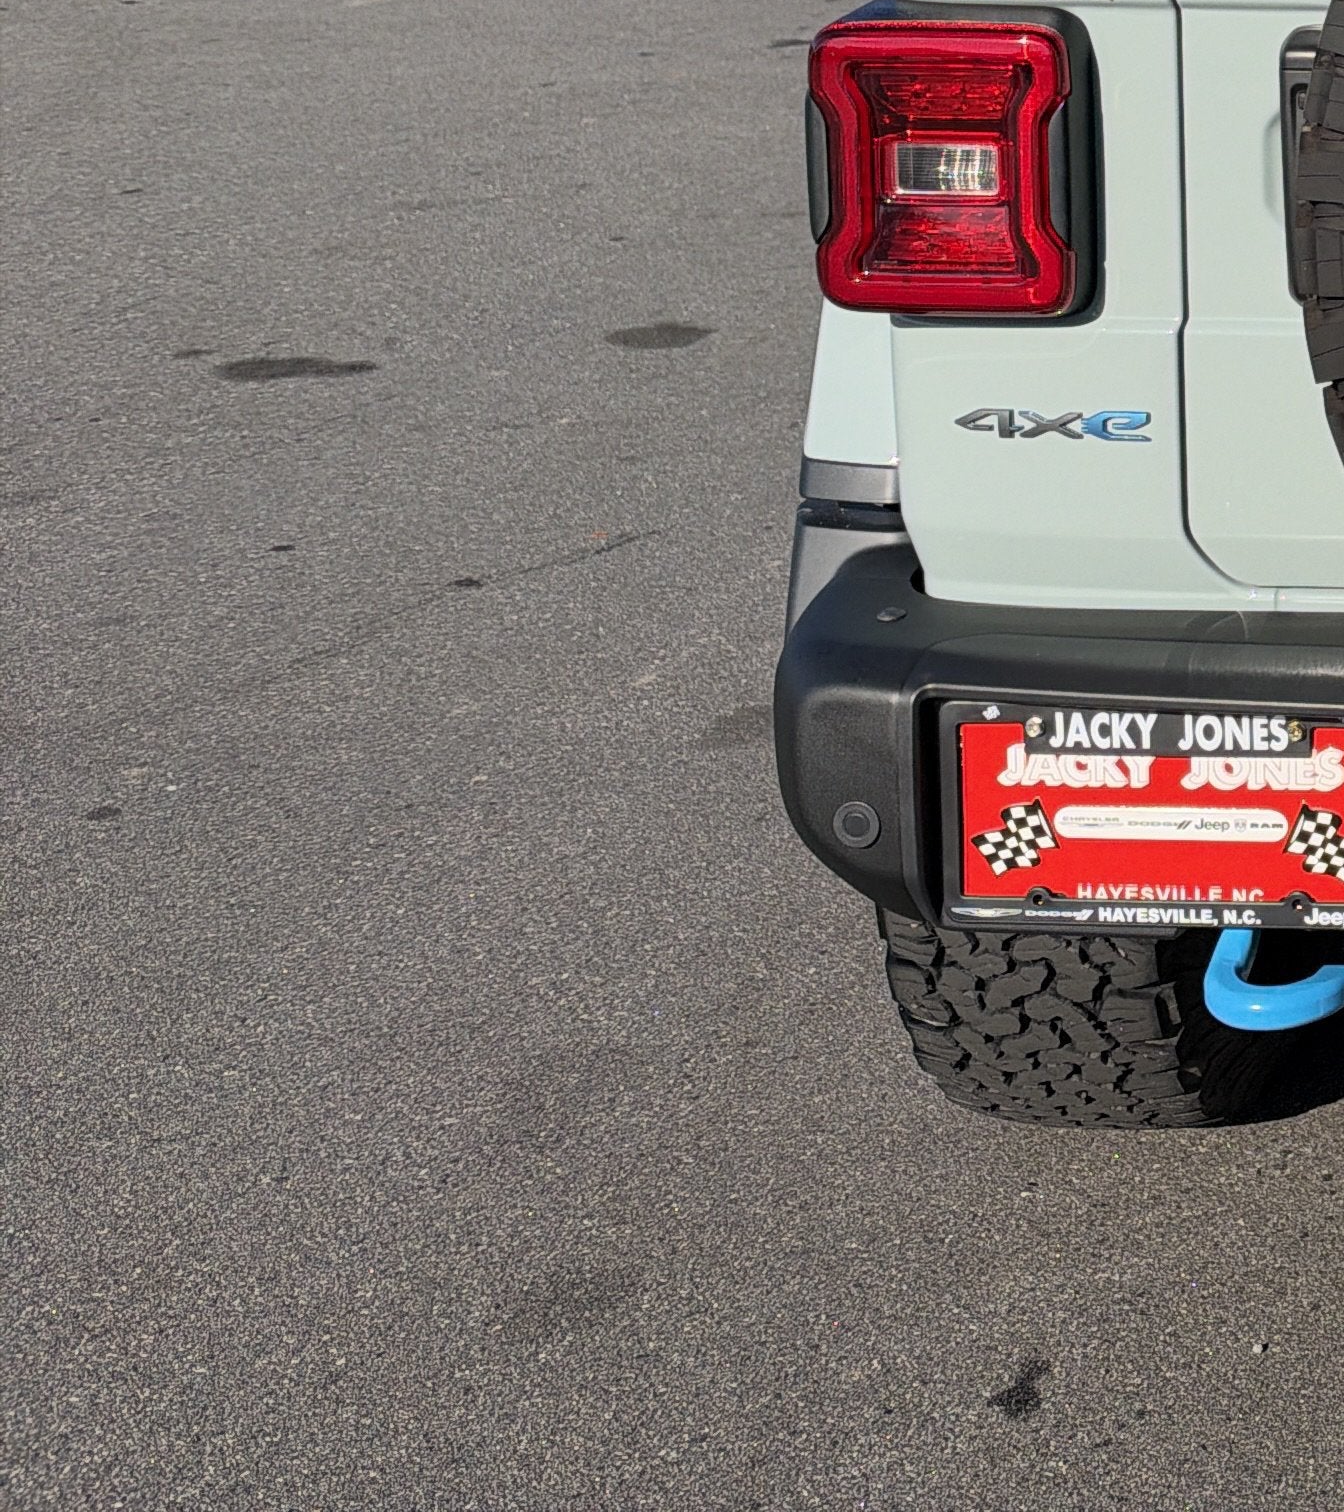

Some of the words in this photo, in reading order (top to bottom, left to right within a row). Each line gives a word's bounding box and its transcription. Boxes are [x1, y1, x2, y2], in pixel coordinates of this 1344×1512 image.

[1048, 711, 1159, 750] JACKY
[1177, 713, 1289, 752] JONES
[996, 742, 1157, 789] JACKY
[1194, 818, 1230, 832] Jeep
[1232, 886, 1265, 902] NC
[1098, 906, 1219, 927] HAYESVILLE,
[1222, 909, 1262, 925] N.C.
